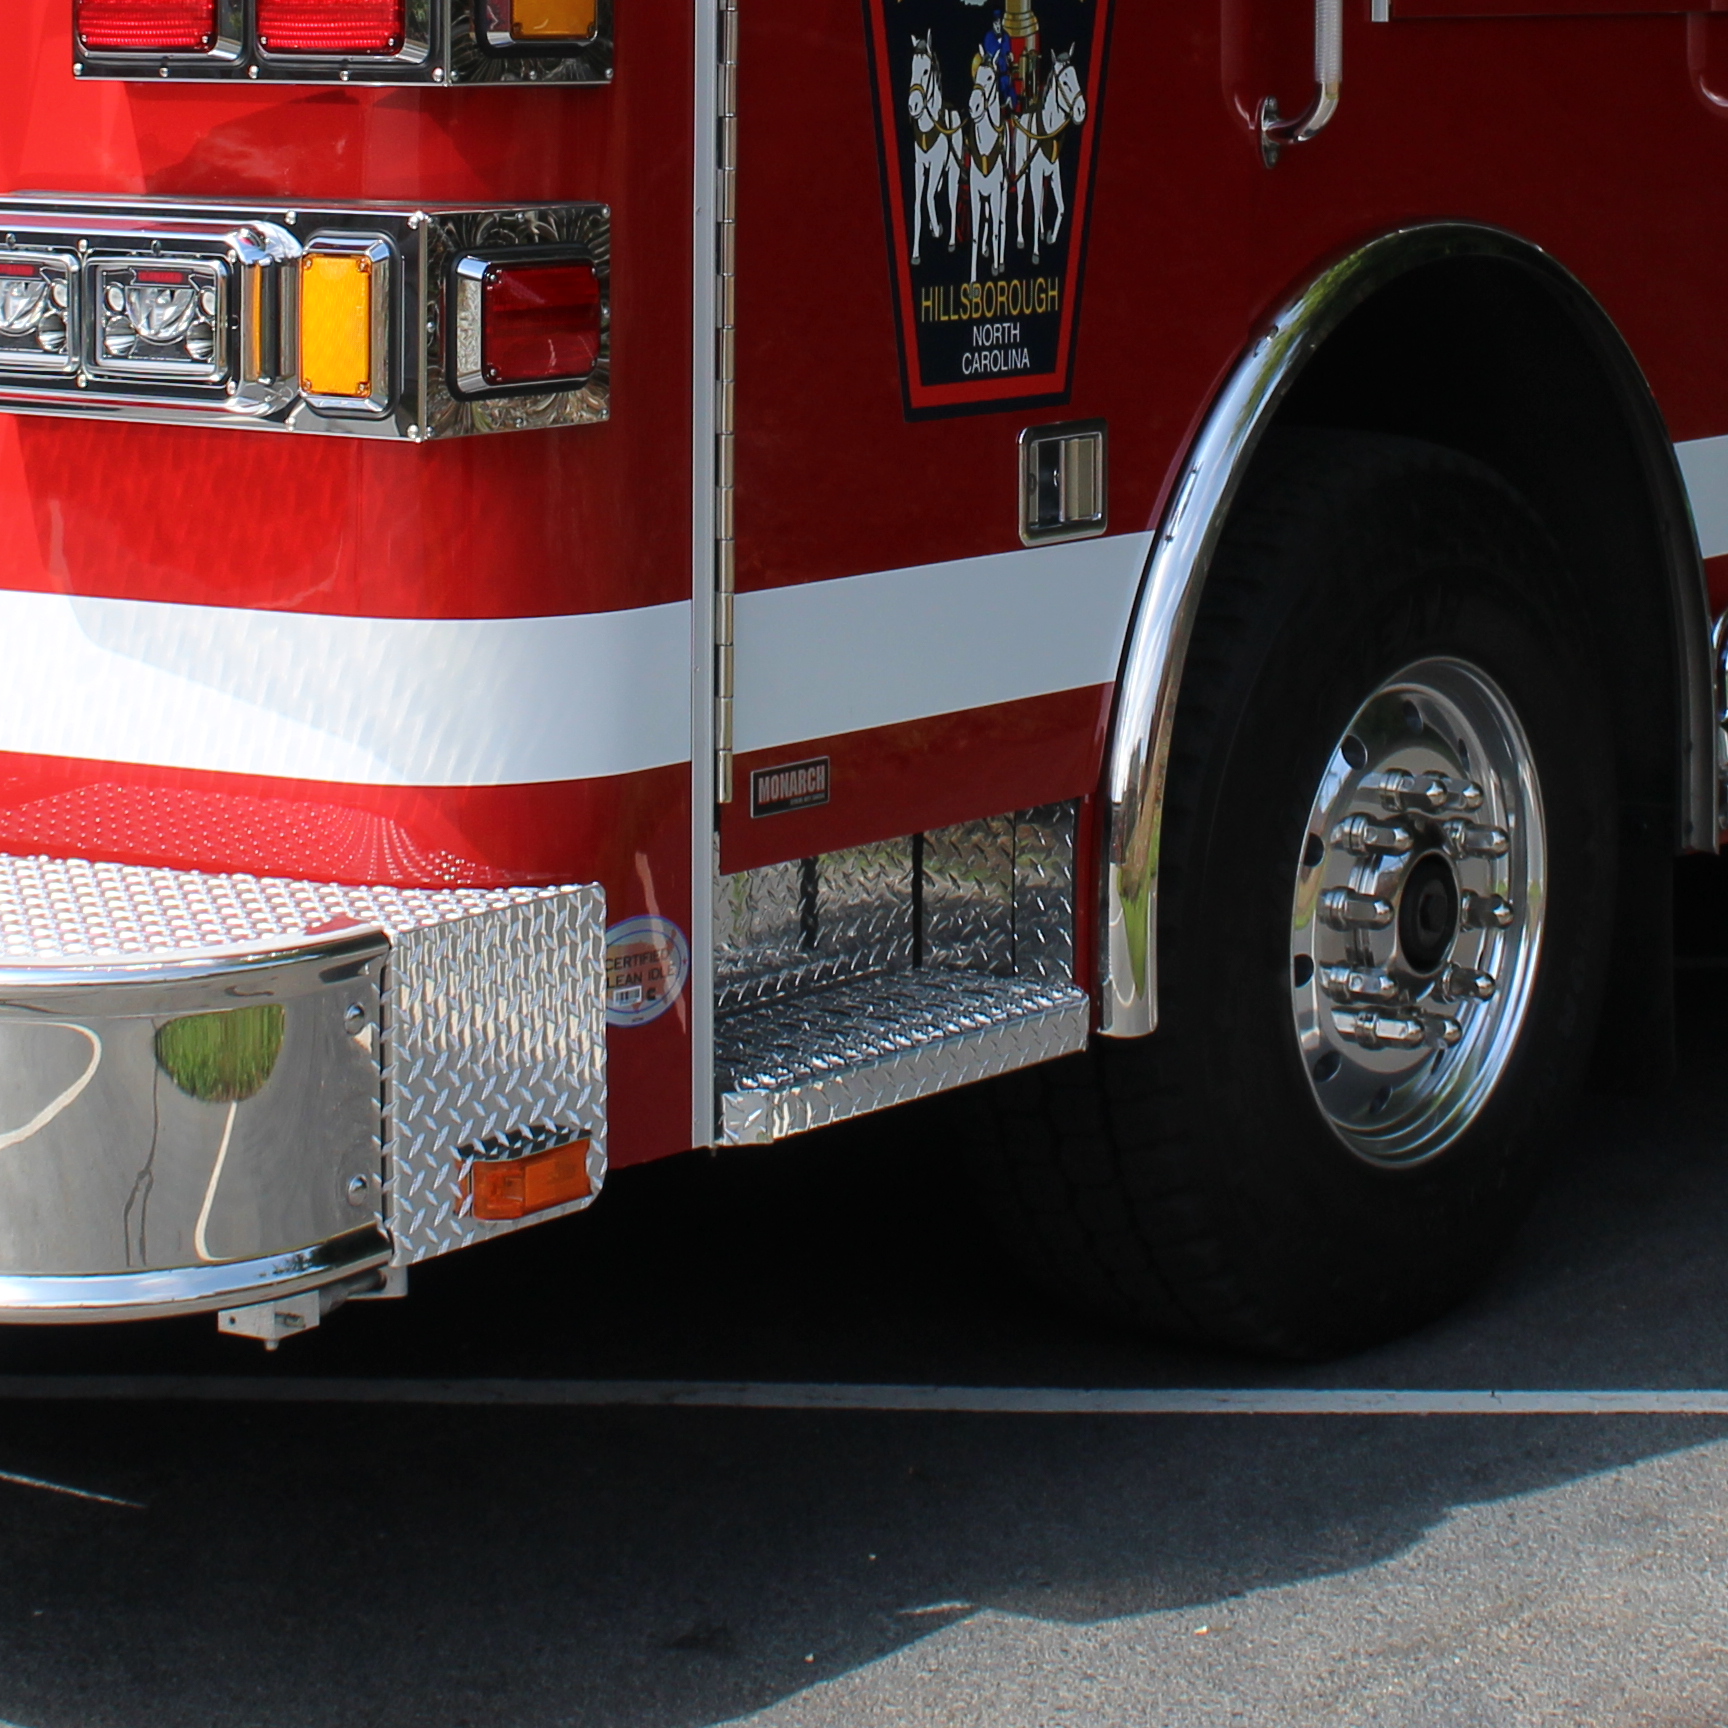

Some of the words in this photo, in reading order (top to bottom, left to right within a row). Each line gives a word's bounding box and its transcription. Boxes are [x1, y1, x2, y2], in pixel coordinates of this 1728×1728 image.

[922, 277, 1059, 322] HILLSBOROUGH
[973, 322, 1020, 347] NORTH
[962, 347, 1031, 375] CAROLINA
[758, 764, 826, 805] MONARCH
[606, 948, 671, 971] CERTIFIED
[606, 972, 643, 989] LEAN
